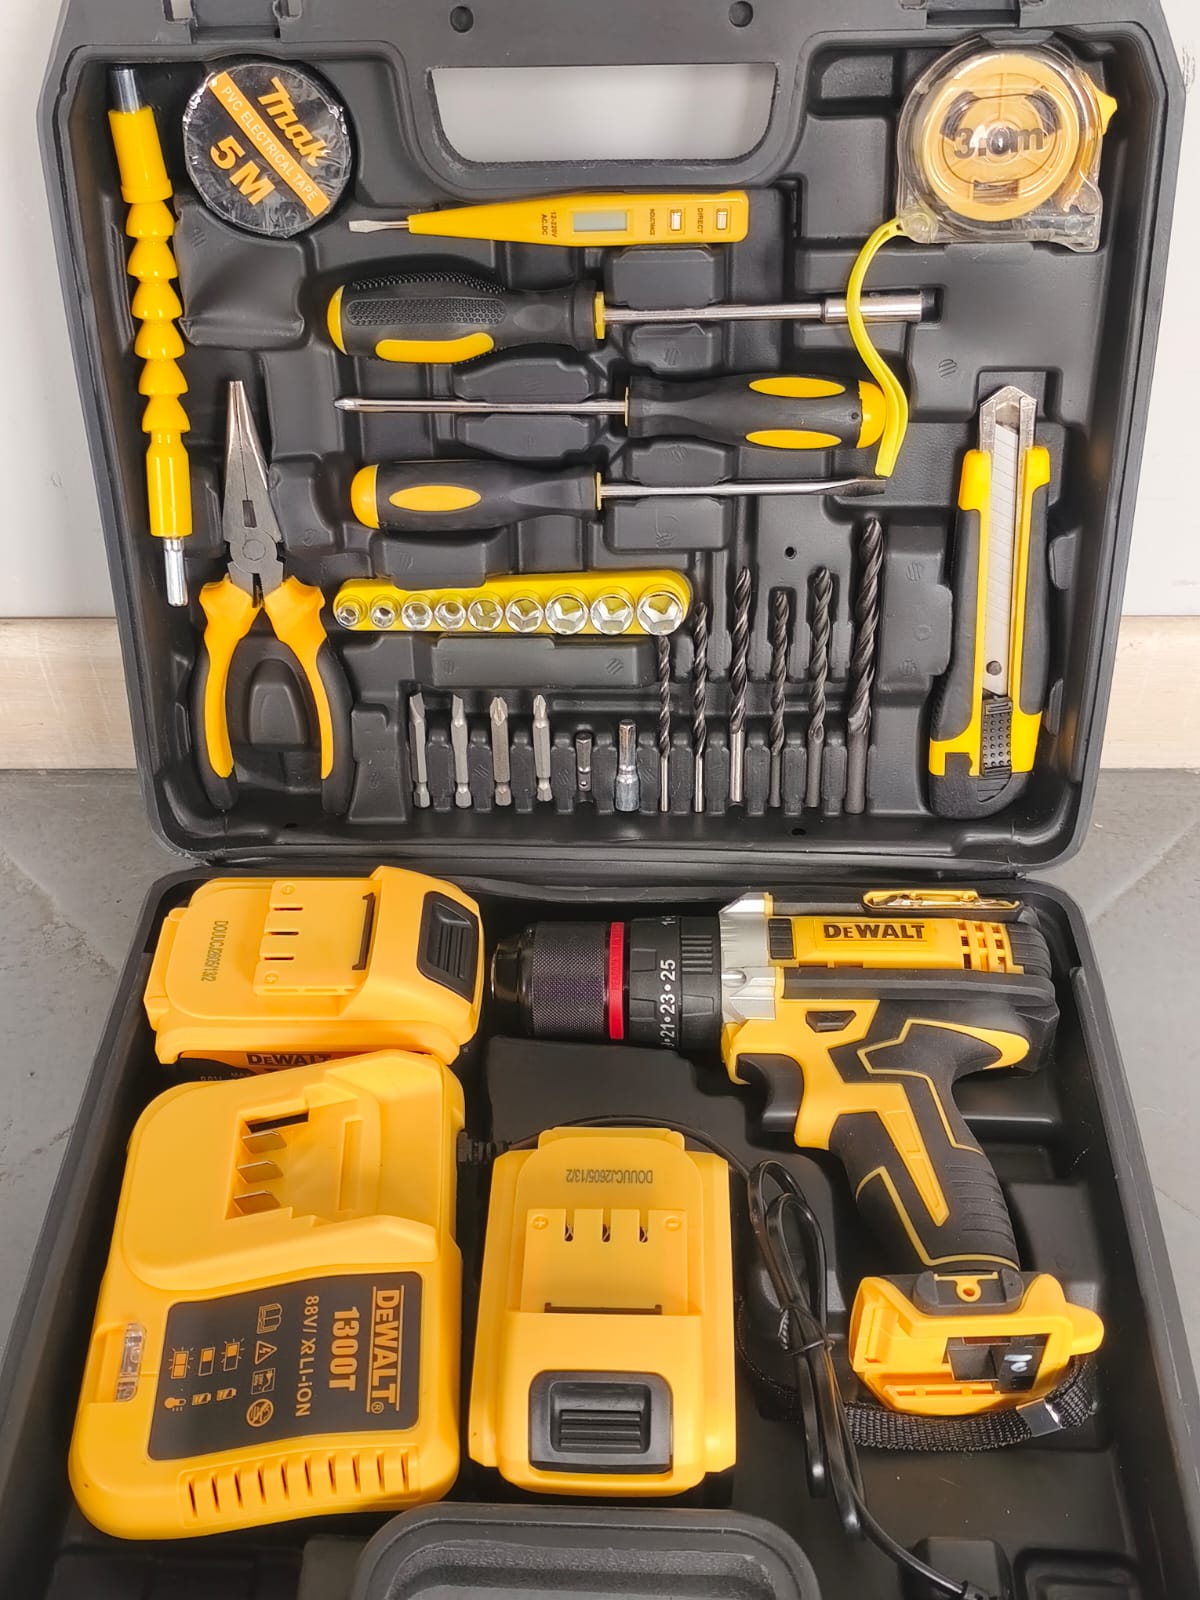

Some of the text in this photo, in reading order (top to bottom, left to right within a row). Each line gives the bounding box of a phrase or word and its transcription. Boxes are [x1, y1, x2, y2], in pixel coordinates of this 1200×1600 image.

[221, 85, 319, 202] PVC ELECTRICAL TAPE
[823, 924, 925, 939] DEWALT
[660, 959, 676, 981] 25
[660, 994, 676, 1015] 23
[328, 1306, 360, 1392] 1300T
